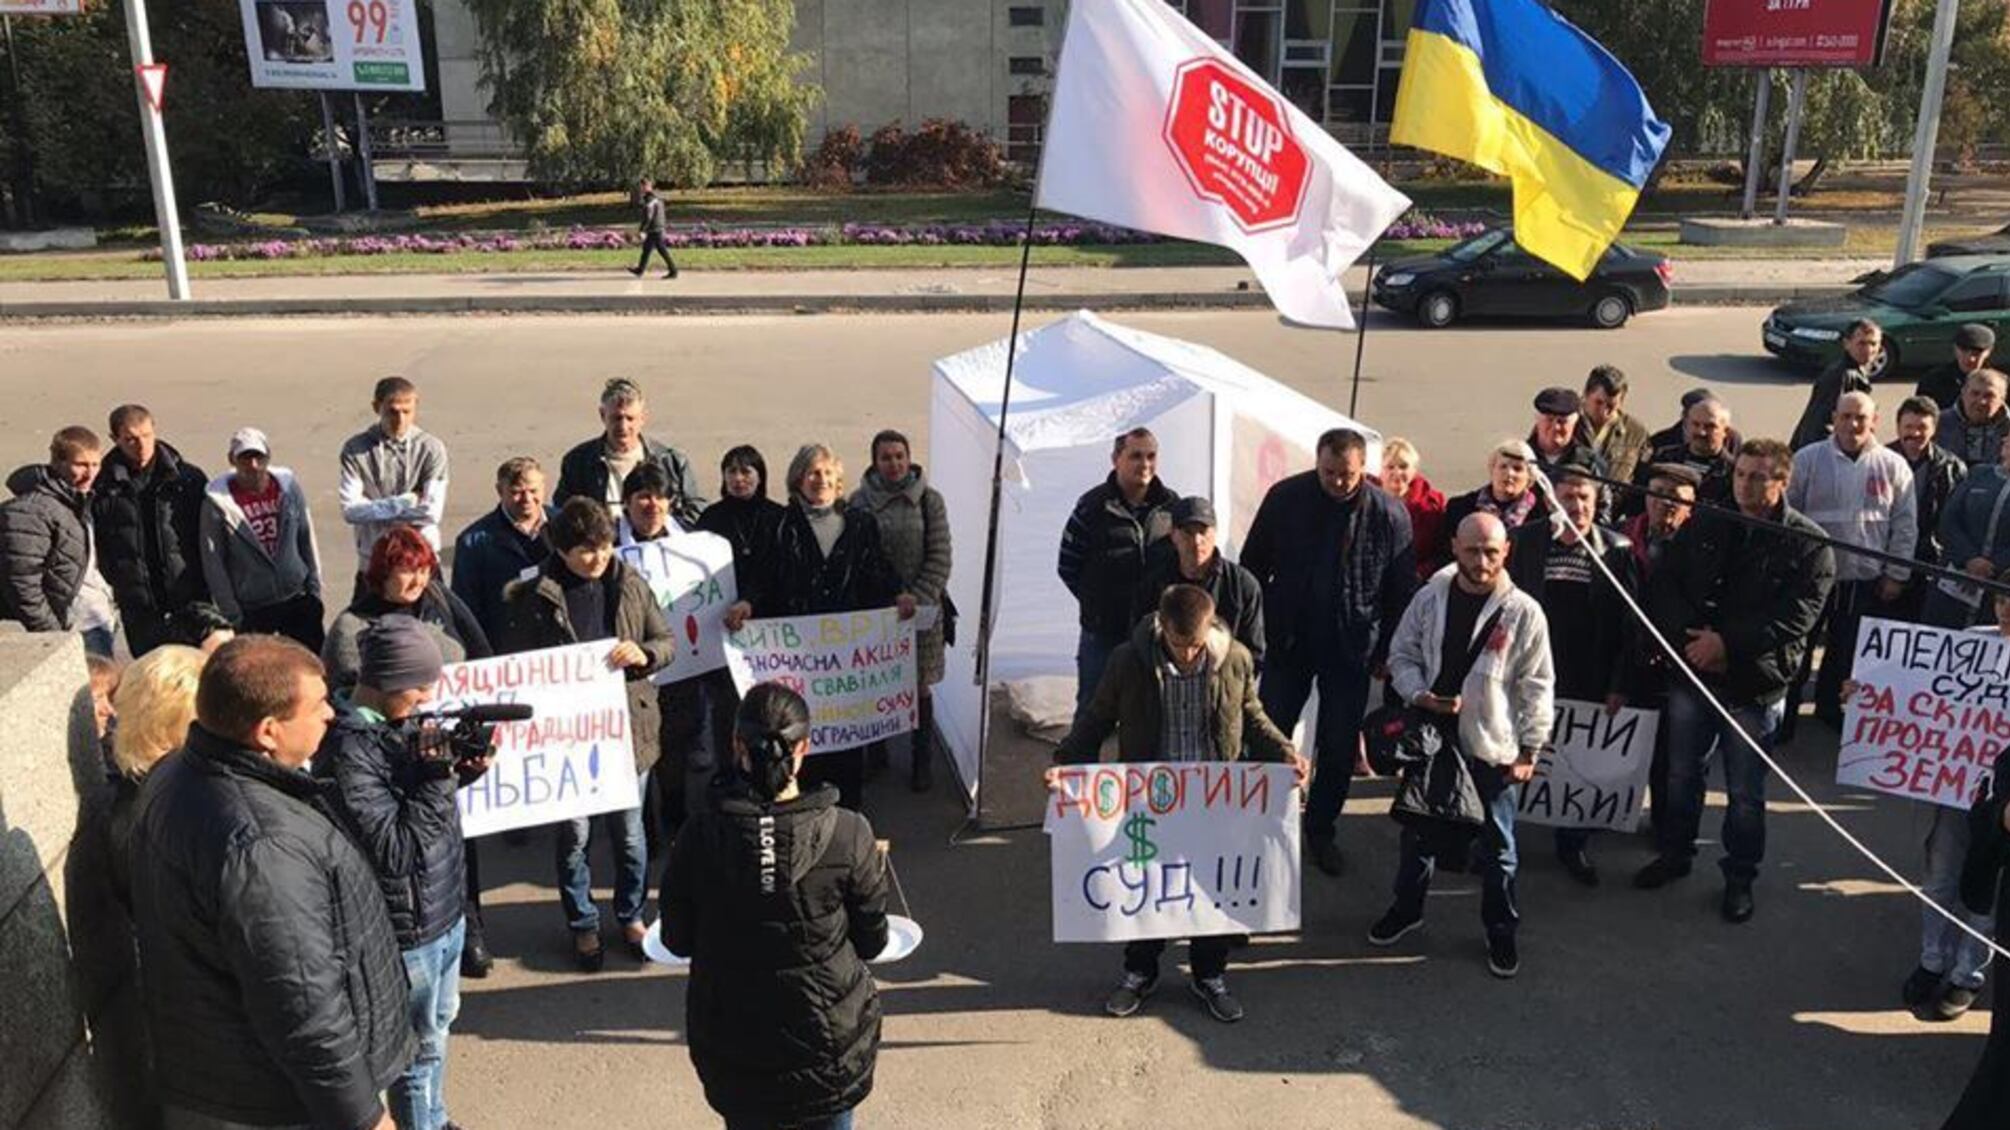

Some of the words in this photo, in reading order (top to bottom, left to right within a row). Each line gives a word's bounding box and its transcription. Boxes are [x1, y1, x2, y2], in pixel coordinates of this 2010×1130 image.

[347, 0, 386, 43] 99
[1856, 682, 1896, 716] ЗА
[1931, 672, 2009, 710] СУД
[1056, 765, 1269, 821] ДОРОГИЙ
[1083, 862, 1195, 916] СУД
